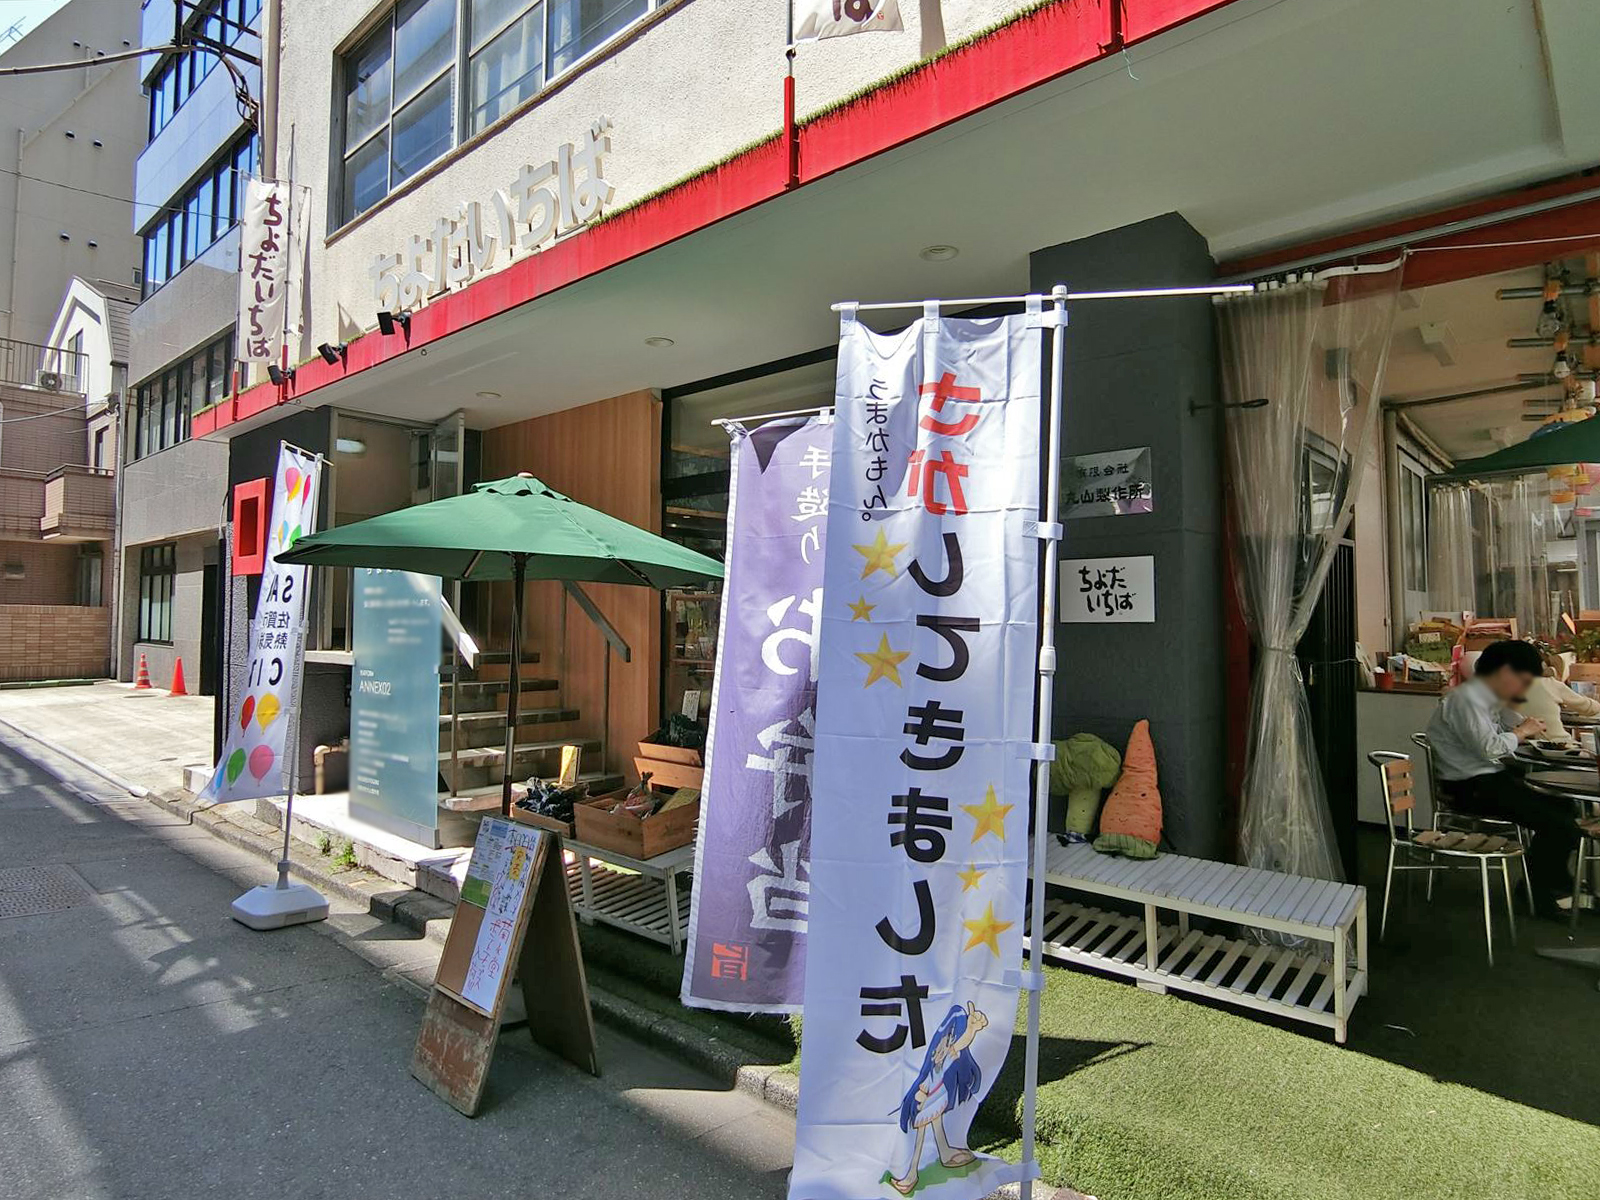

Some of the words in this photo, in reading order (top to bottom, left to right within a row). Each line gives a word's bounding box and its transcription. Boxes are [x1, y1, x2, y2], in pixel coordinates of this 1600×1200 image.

[369, 114, 616, 315] ちよだいちば
[247, 193, 282, 357] ちよだいちば
[1078, 565, 1127, 593] ちよだ
[1086, 589, 1136, 616] いちば
